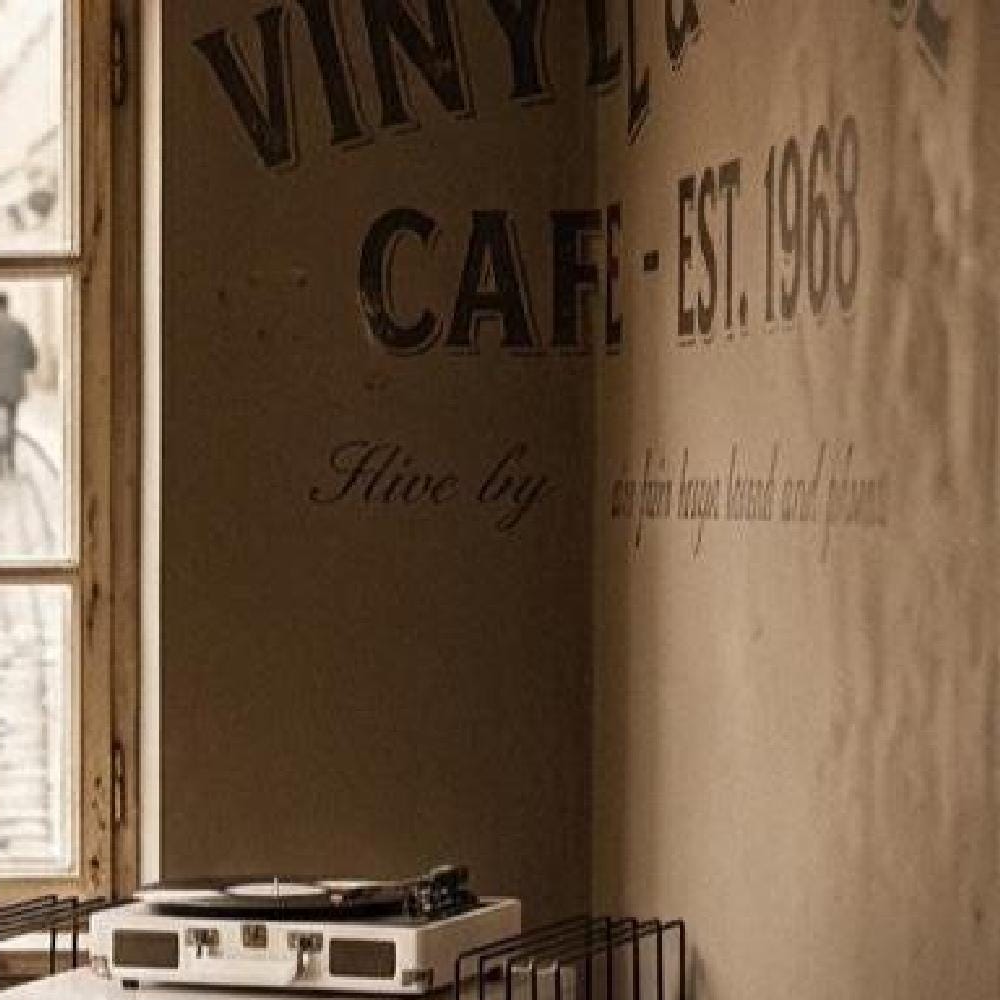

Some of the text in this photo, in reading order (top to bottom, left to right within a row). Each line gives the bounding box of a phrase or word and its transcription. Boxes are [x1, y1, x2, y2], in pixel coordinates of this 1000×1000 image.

[358, 203, 622, 355] CAFE
[677, 157, 750, 342] EST.
[764, 113, 861, 326] 1968
[477, 441, 552, 531] by
